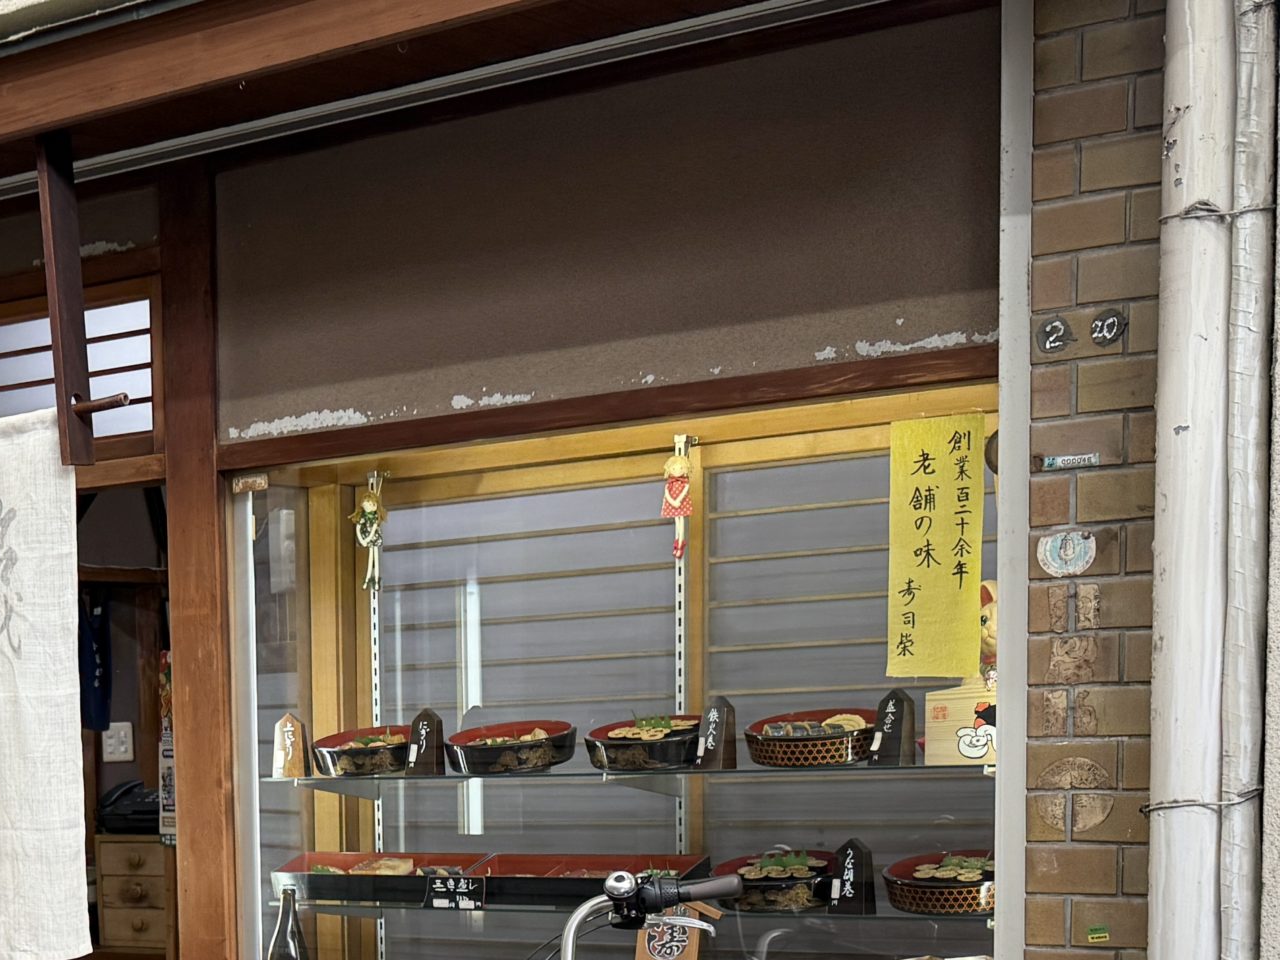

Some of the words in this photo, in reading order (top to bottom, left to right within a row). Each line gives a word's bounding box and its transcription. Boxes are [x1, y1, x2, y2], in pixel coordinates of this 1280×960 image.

[1045, 321, 1064, 348] 2
[908, 449, 941, 568] 老舗の味
[947, 430, 972, 590] 創業百二十余年
[707, 708, 719, 749] 鉄火巻
[883, 699, 896, 732] 盛合せ
[419, 720, 430, 754] にぎり
